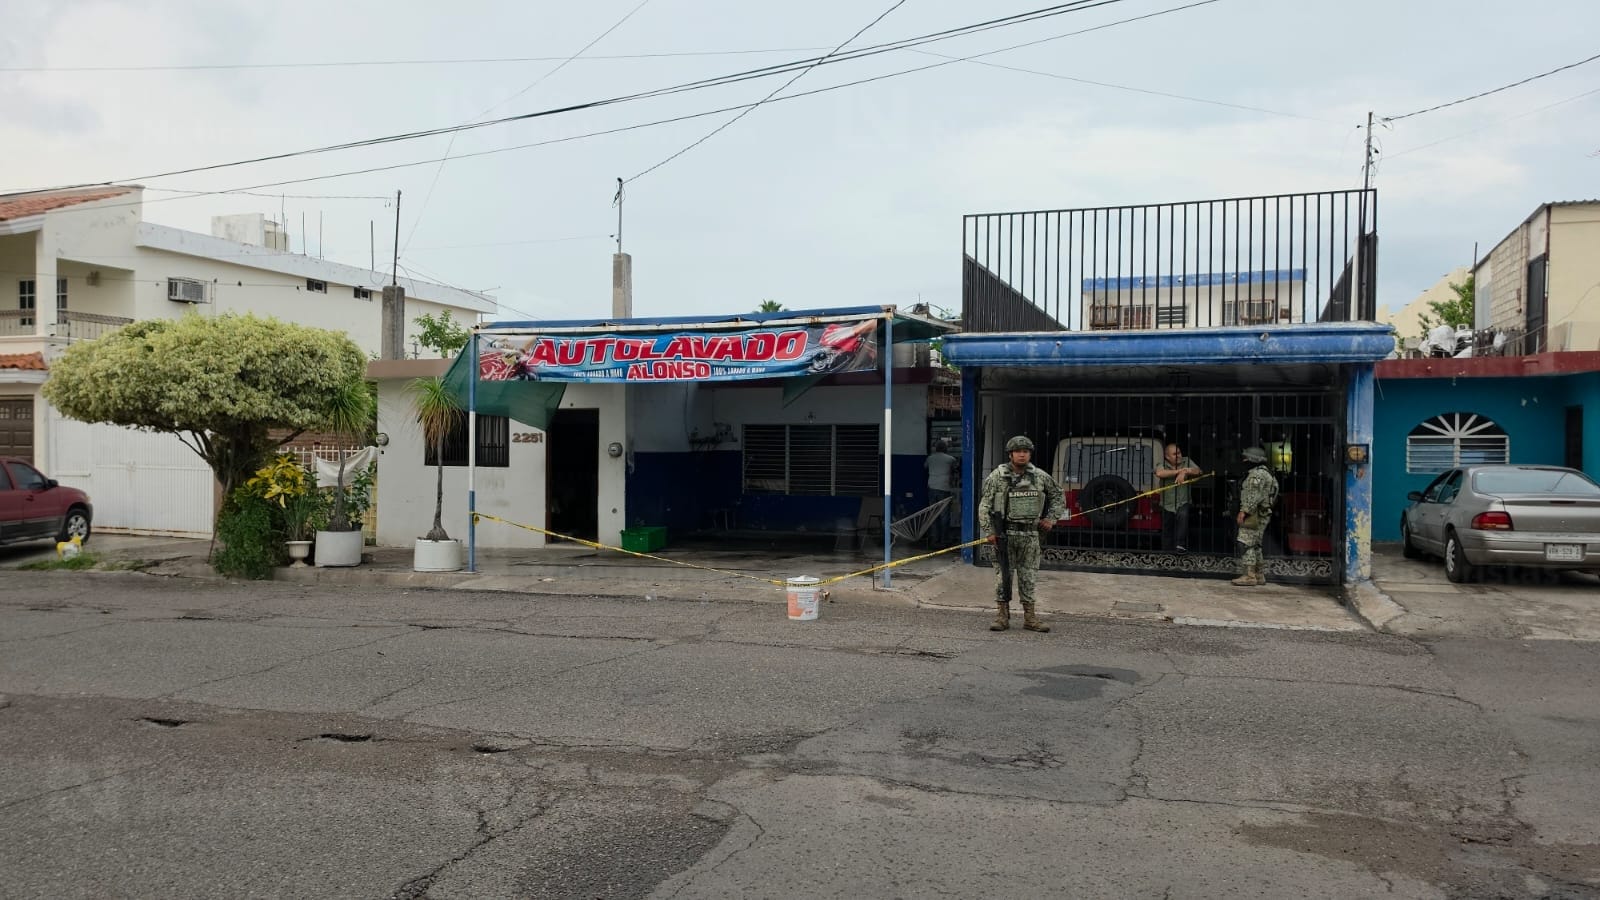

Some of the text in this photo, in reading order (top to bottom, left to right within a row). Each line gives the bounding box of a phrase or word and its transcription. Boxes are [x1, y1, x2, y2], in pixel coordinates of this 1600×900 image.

[527, 330, 809, 366] AUTOLAVADO
[626, 360, 711, 380] ALONSO
[512, 432, 543, 443] 2251
